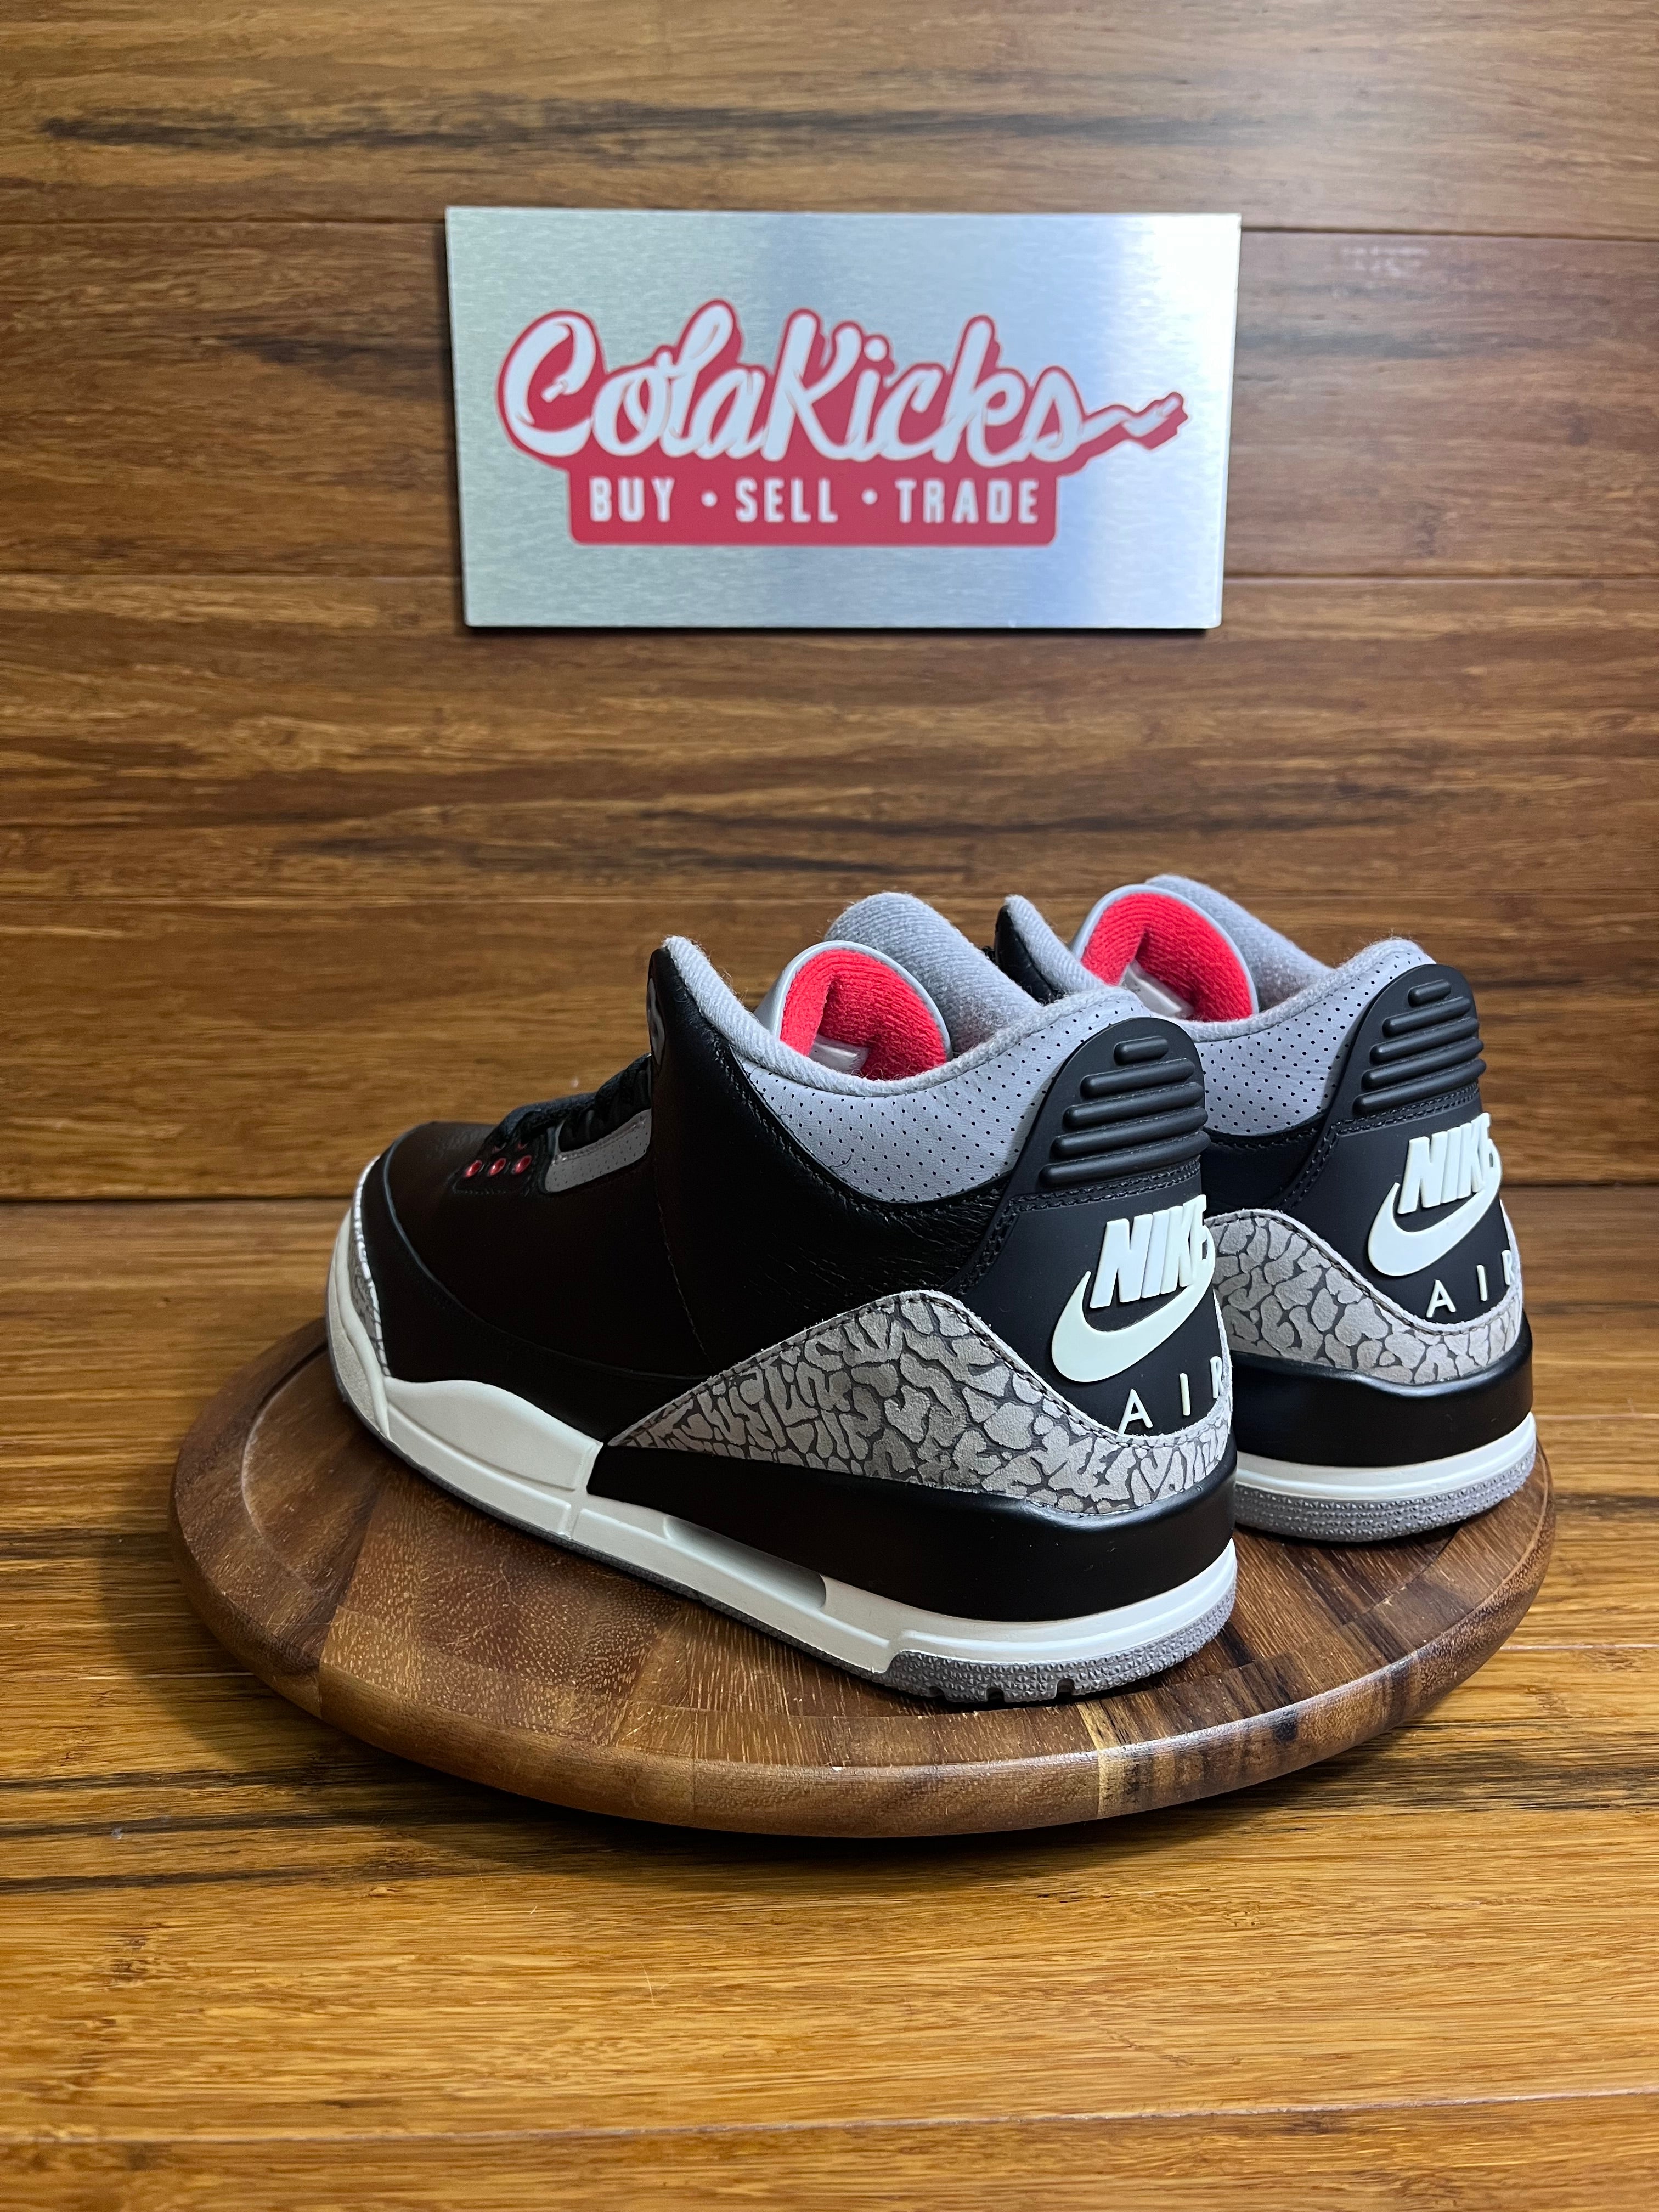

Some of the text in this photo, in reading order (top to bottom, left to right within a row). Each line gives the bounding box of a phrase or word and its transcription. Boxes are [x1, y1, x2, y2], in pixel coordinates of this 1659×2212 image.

[590, 478, 1039, 524] BUY SELL TRADE
